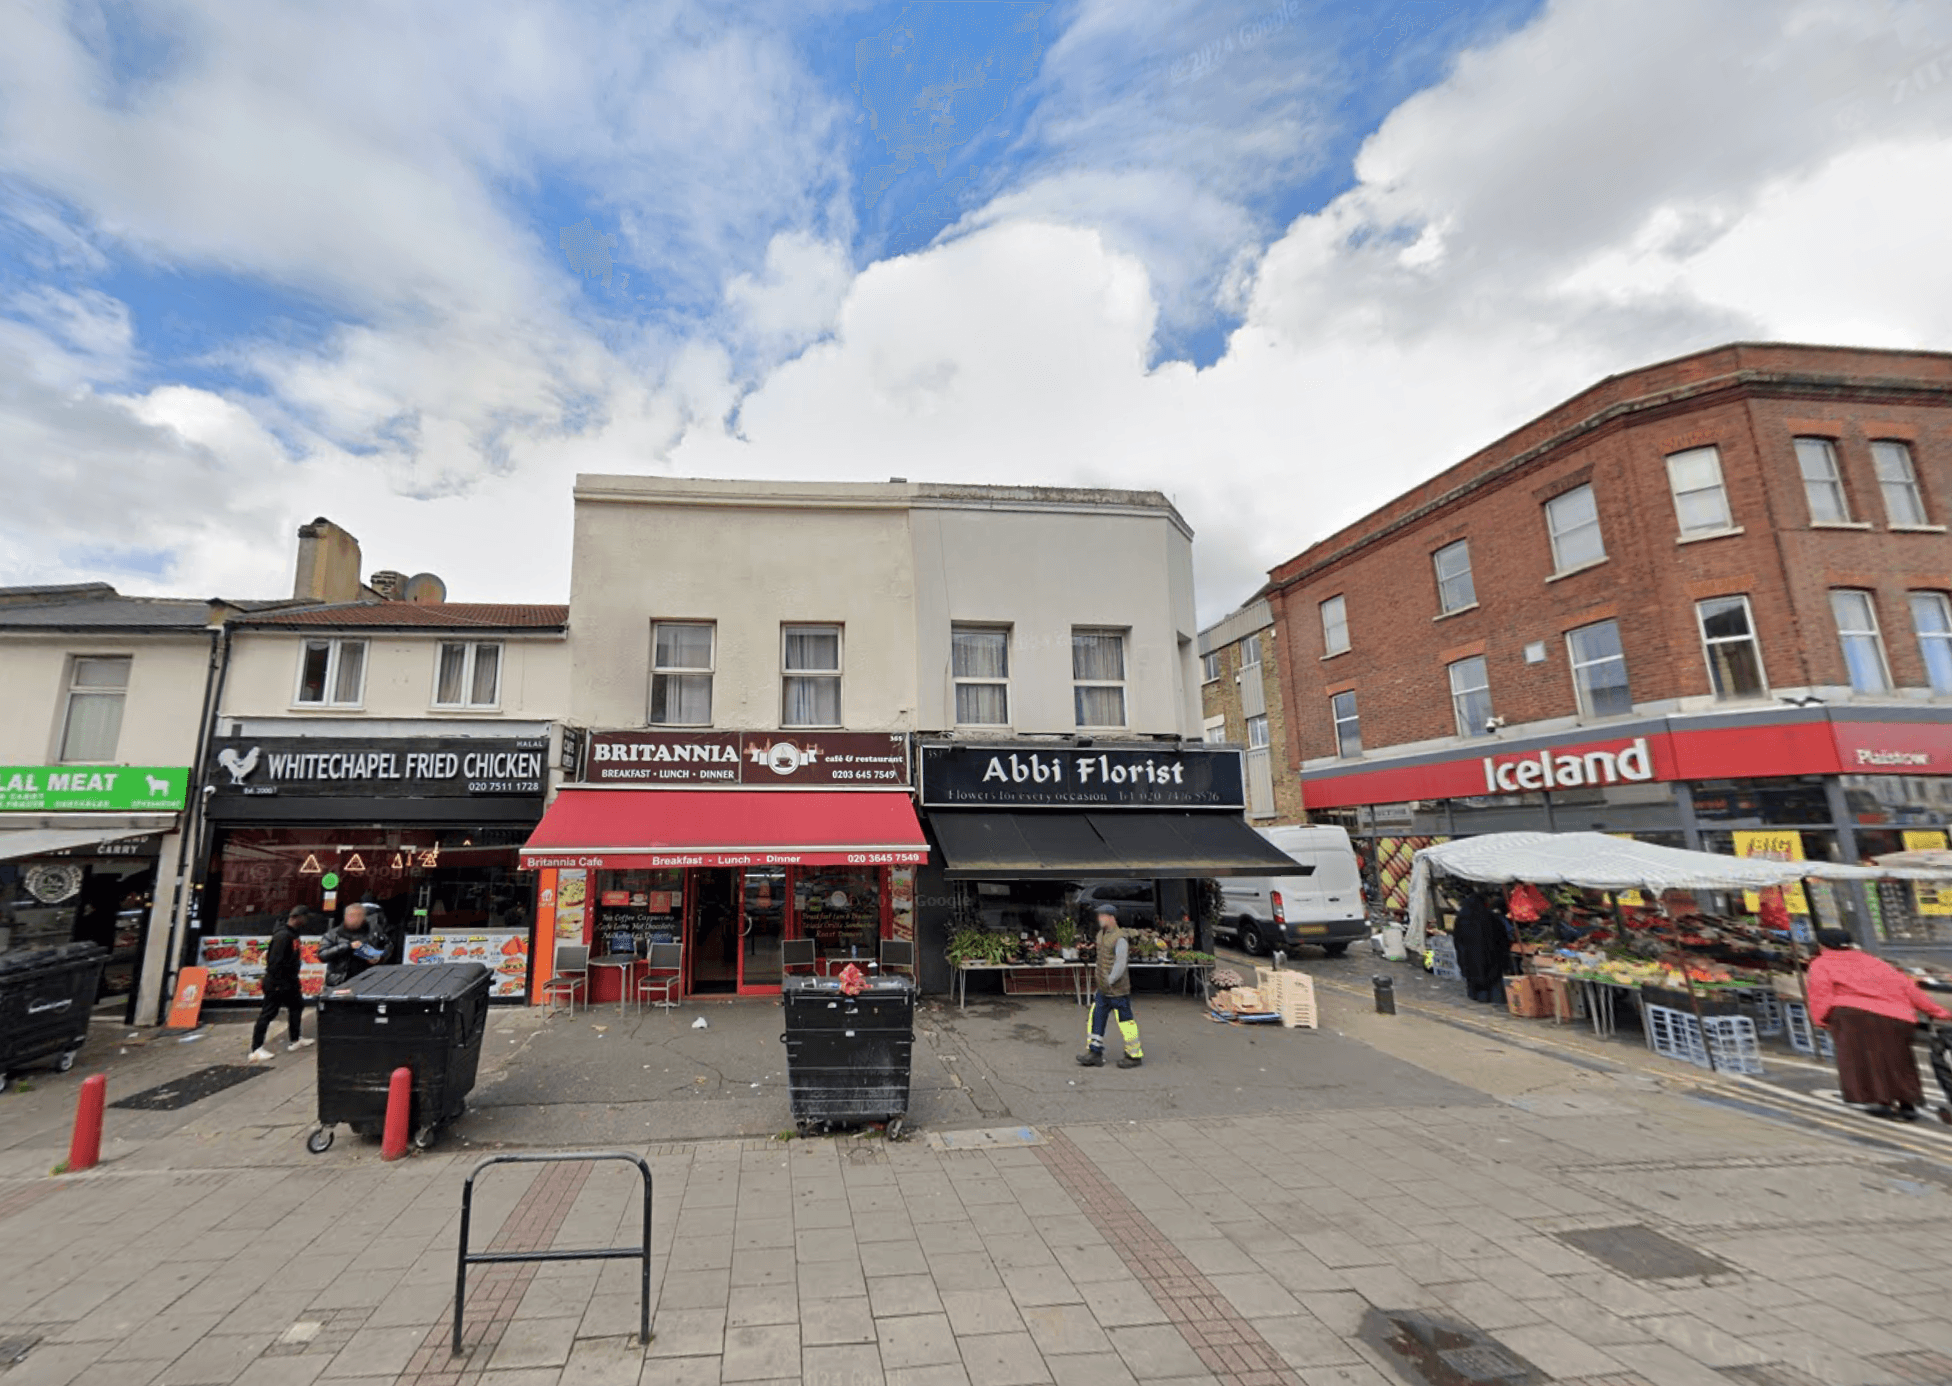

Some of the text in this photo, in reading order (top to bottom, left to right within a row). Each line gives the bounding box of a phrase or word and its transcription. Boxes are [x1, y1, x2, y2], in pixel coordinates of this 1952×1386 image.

[516, 740, 543, 748] HALAL
[594, 743, 740, 762] BRITANNIA
[1855, 749, 1928, 765] Plaistow
[824, 755, 844, 763] café
[855, 755, 904, 763] restaurant
[1483, 737, 1652, 792] Iceland
[268, 752, 542, 779] WHITECHAPEL FRIED CHICKEN
[982, 753, 1185, 784] Abbi Florist
[601, 769, 734, 779] BREAKFAST LUNCH DINNER
[832, 770, 896, 779] 0203 645 7549
[47, 773, 119, 791] MEAT
[468, 782, 539, 791] 020 7511 1728
[1055, 792, 1108, 801] occasion
[97, 844, 139, 854] CARRY
[527, 854, 801, 867] Britannia Cafe Breakfast Lunch Dinner
[848, 852, 920, 863] 020 3645 7549
